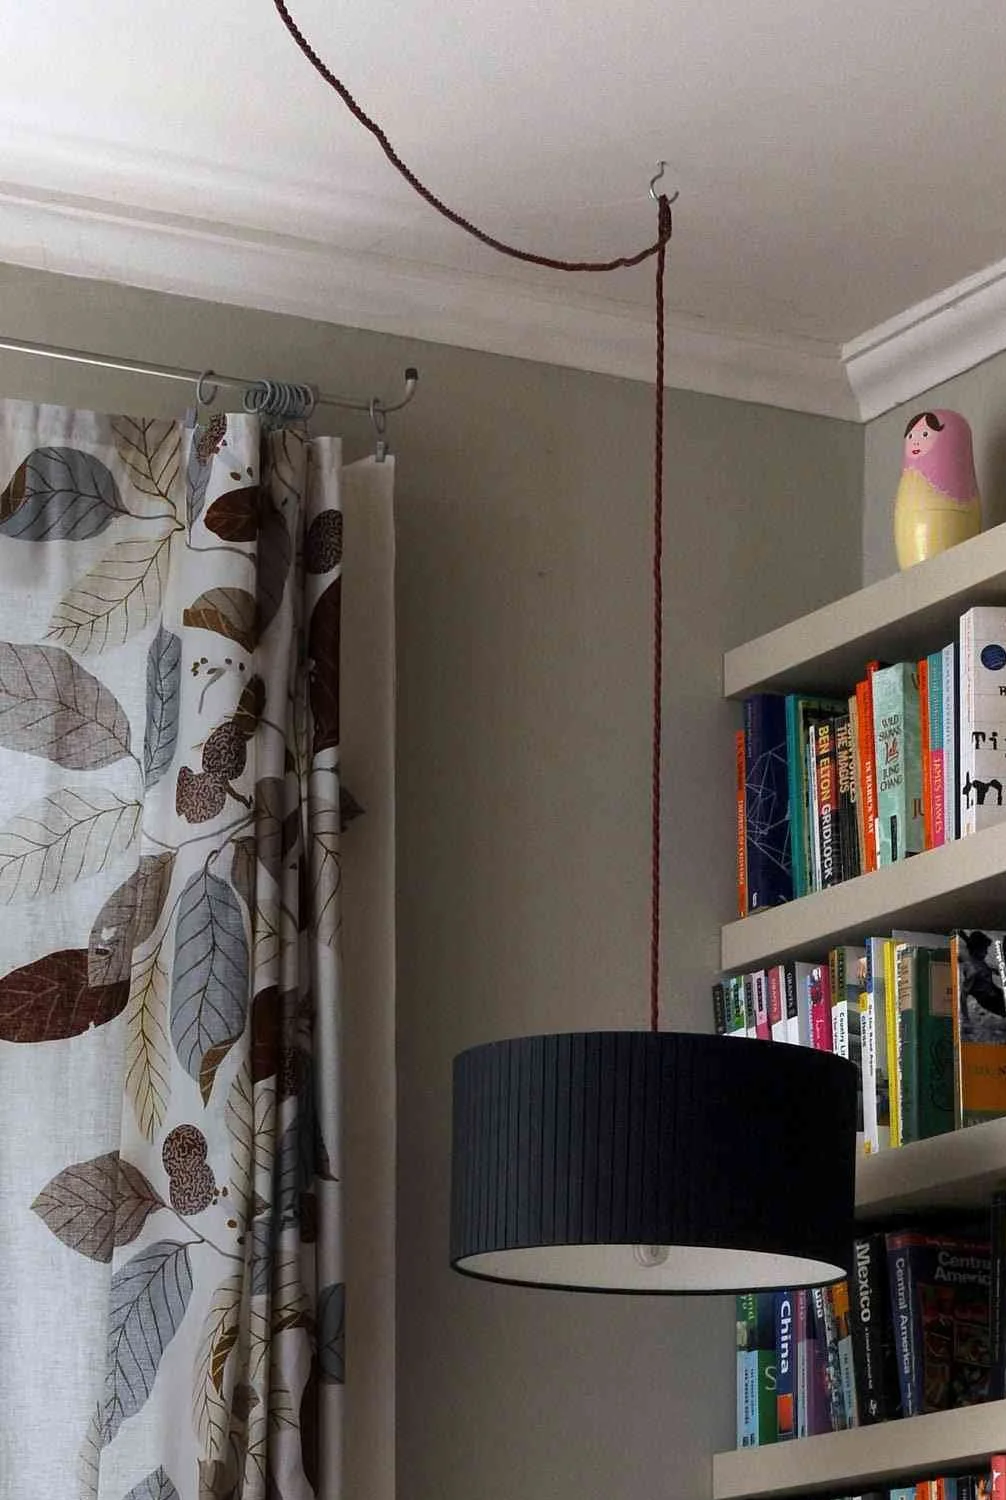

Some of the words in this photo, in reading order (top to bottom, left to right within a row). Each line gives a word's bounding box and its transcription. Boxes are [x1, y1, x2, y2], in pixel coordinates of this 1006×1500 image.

[818, 726, 830, 754] BEN
[836, 726, 846, 749] THE
[820, 758, 831, 801] ELTON
[838, 752, 848, 794] MAGUS
[822, 804, 833, 881] GRIDLOCK
[856, 1242, 872, 1323] Mexico
[896, 1257, 907, 1310] Central
[780, 1300, 791, 1374] China
[900, 1314, 912, 1374] America
